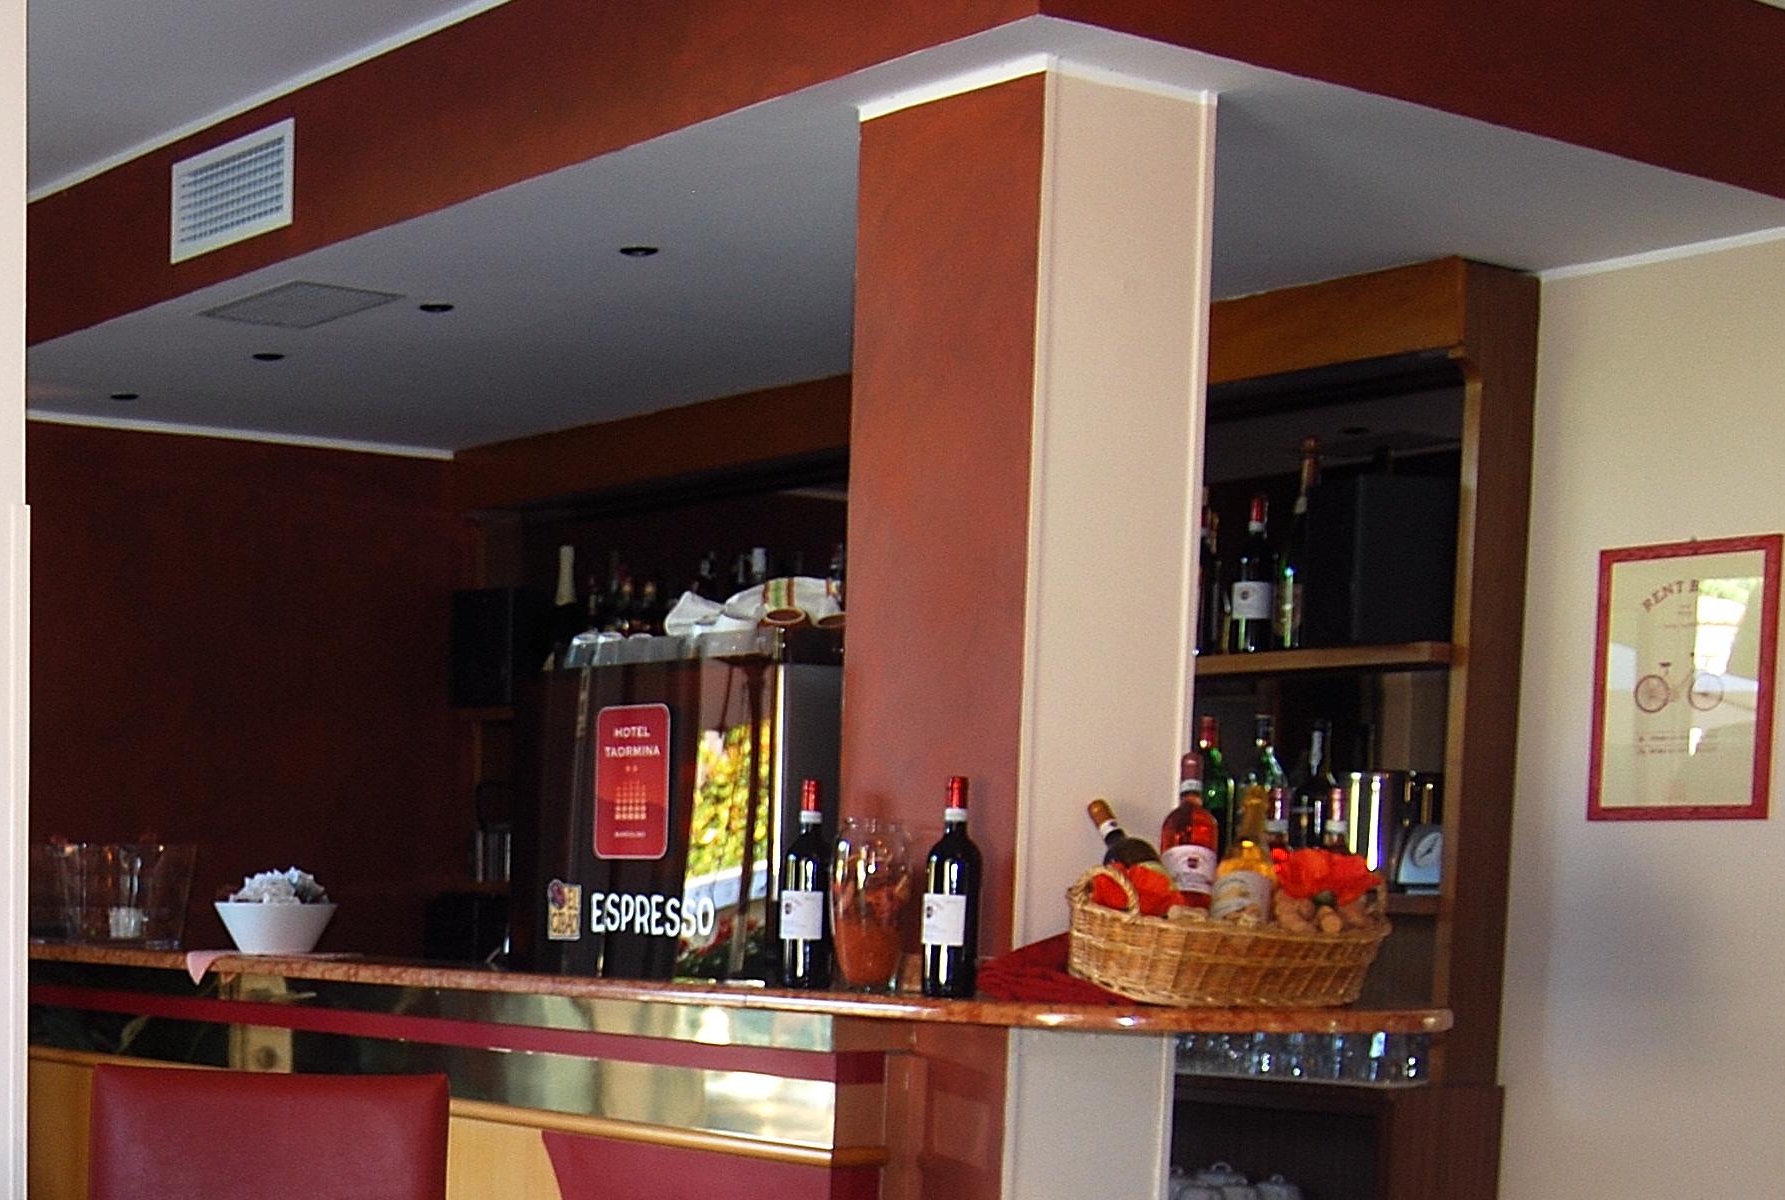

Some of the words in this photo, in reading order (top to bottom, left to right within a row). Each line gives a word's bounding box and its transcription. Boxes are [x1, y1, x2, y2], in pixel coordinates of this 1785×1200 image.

[1642, 580, 1684, 613] RENT
[614, 726, 651, 739] HOTEL
[604, 745, 661, 758] TAORMINA
[591, 892, 715, 938] ESPRESSO
